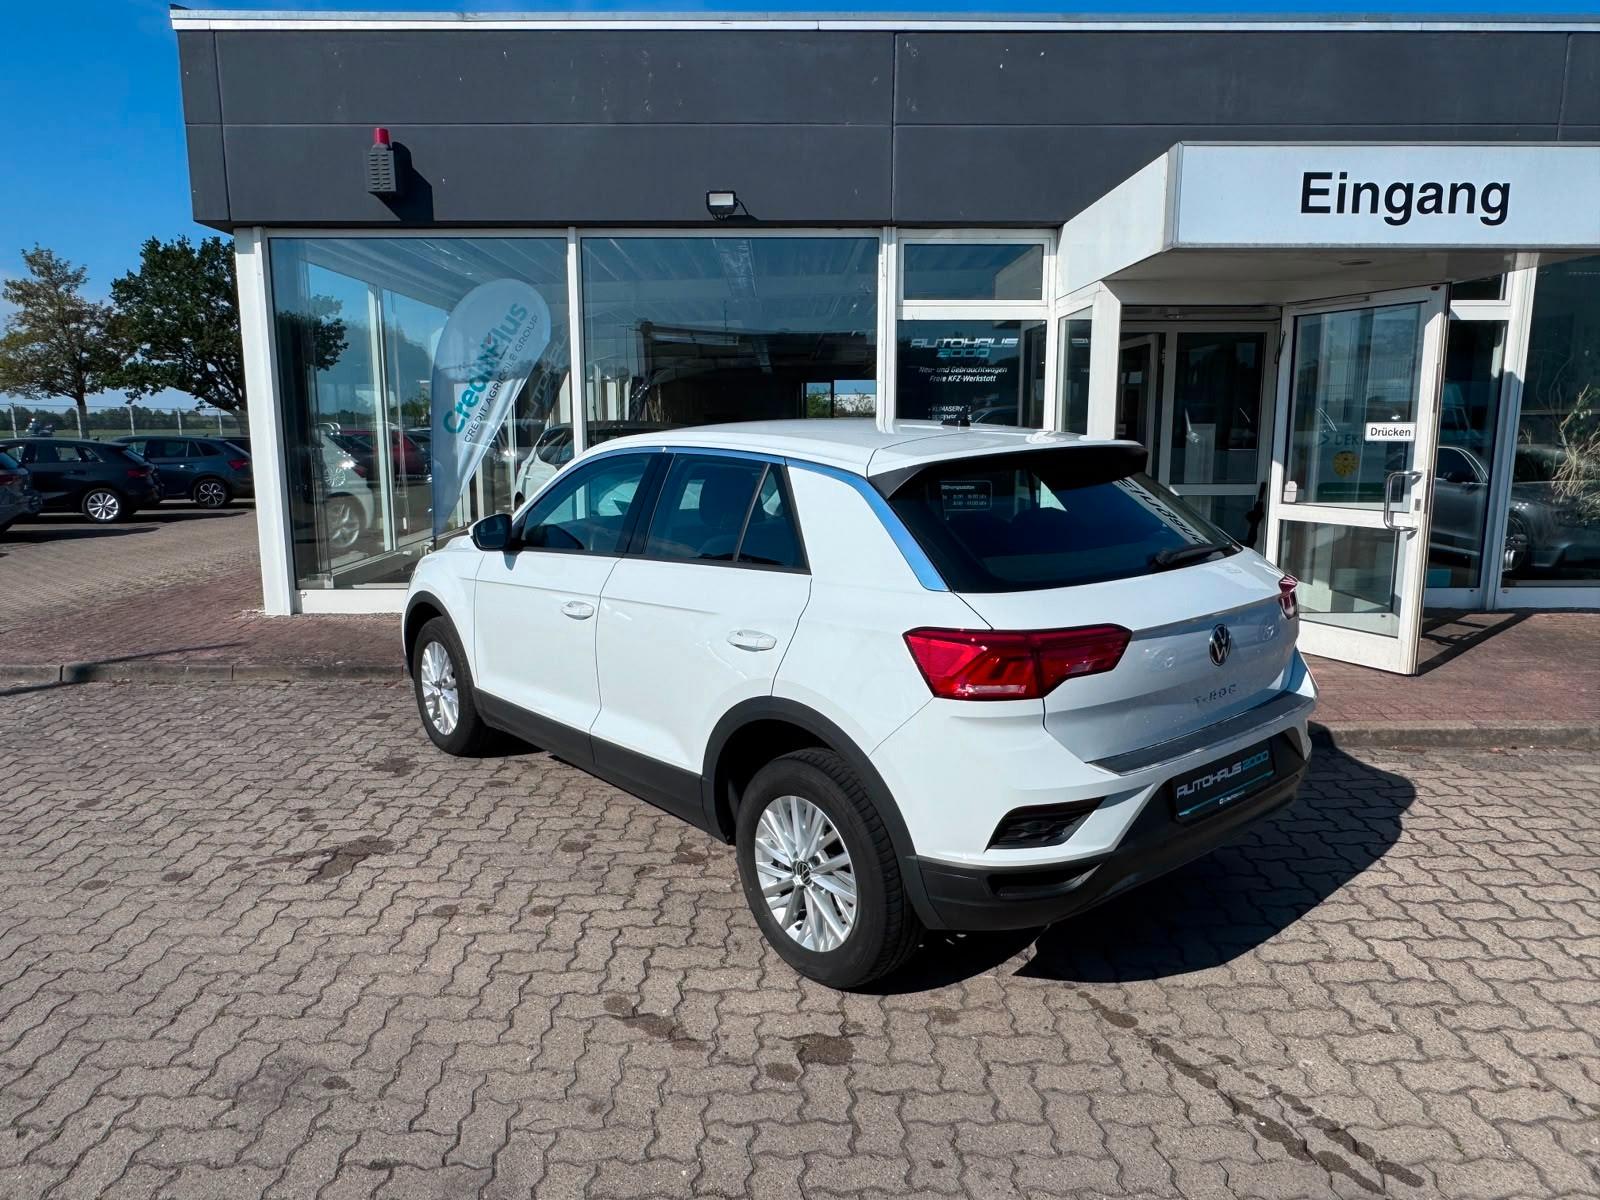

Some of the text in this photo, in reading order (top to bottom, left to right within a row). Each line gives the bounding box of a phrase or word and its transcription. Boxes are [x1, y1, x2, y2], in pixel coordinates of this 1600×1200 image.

[1301, 171, 1510, 226] Eingang
[515, 315, 539, 353] GROUP
[910, 337, 1019, 348] AUTOHAUS
[937, 348, 991, 358] 2000
[947, 374, 997, 383] KFZ-Werkstatt
[1370, 427, 1411, 437] Drücken
[1176, 761, 1242, 799] AUTOHAUS
[1242, 750, 1269, 771] 2000
